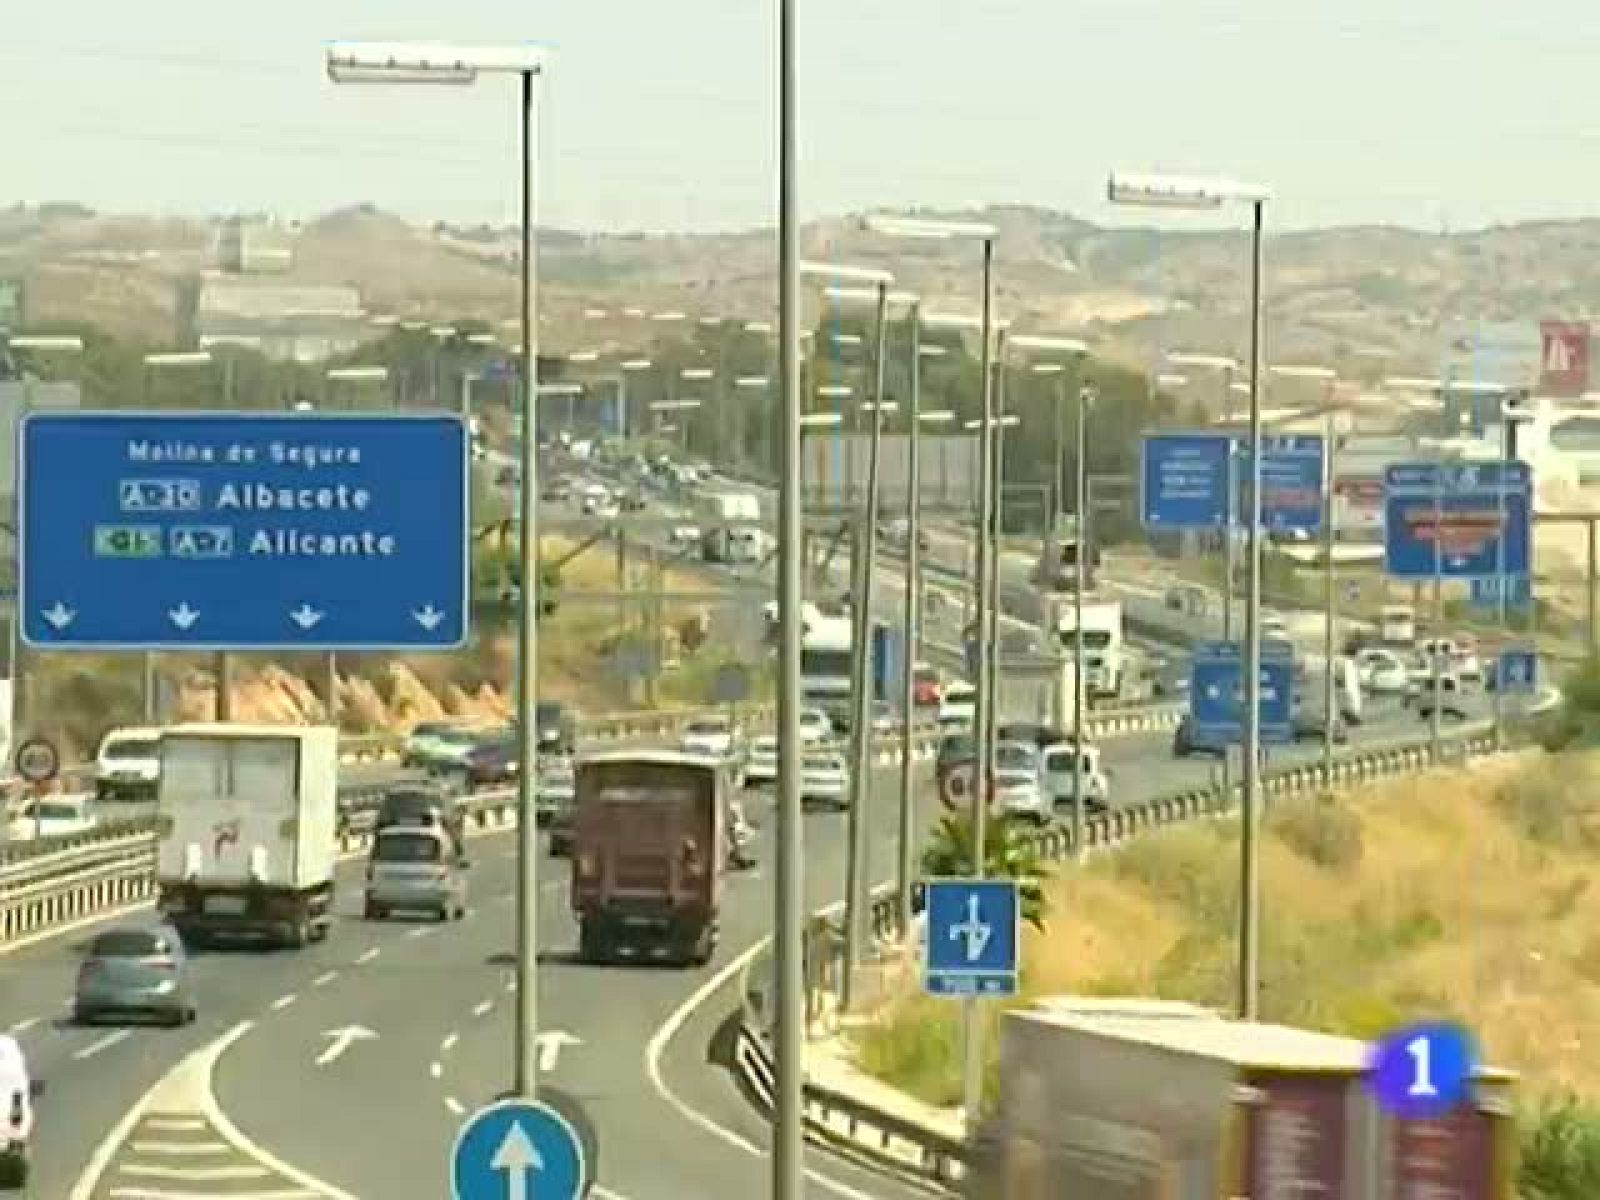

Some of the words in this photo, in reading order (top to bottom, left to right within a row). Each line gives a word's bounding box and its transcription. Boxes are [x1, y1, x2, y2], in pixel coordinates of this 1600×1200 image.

[128, 439, 213, 462] Molina
[227, 443, 257, 463] de
[269, 441, 361, 470] Segura
[217, 483, 371, 510] Albacete
[250, 529, 395, 555] Alicante
